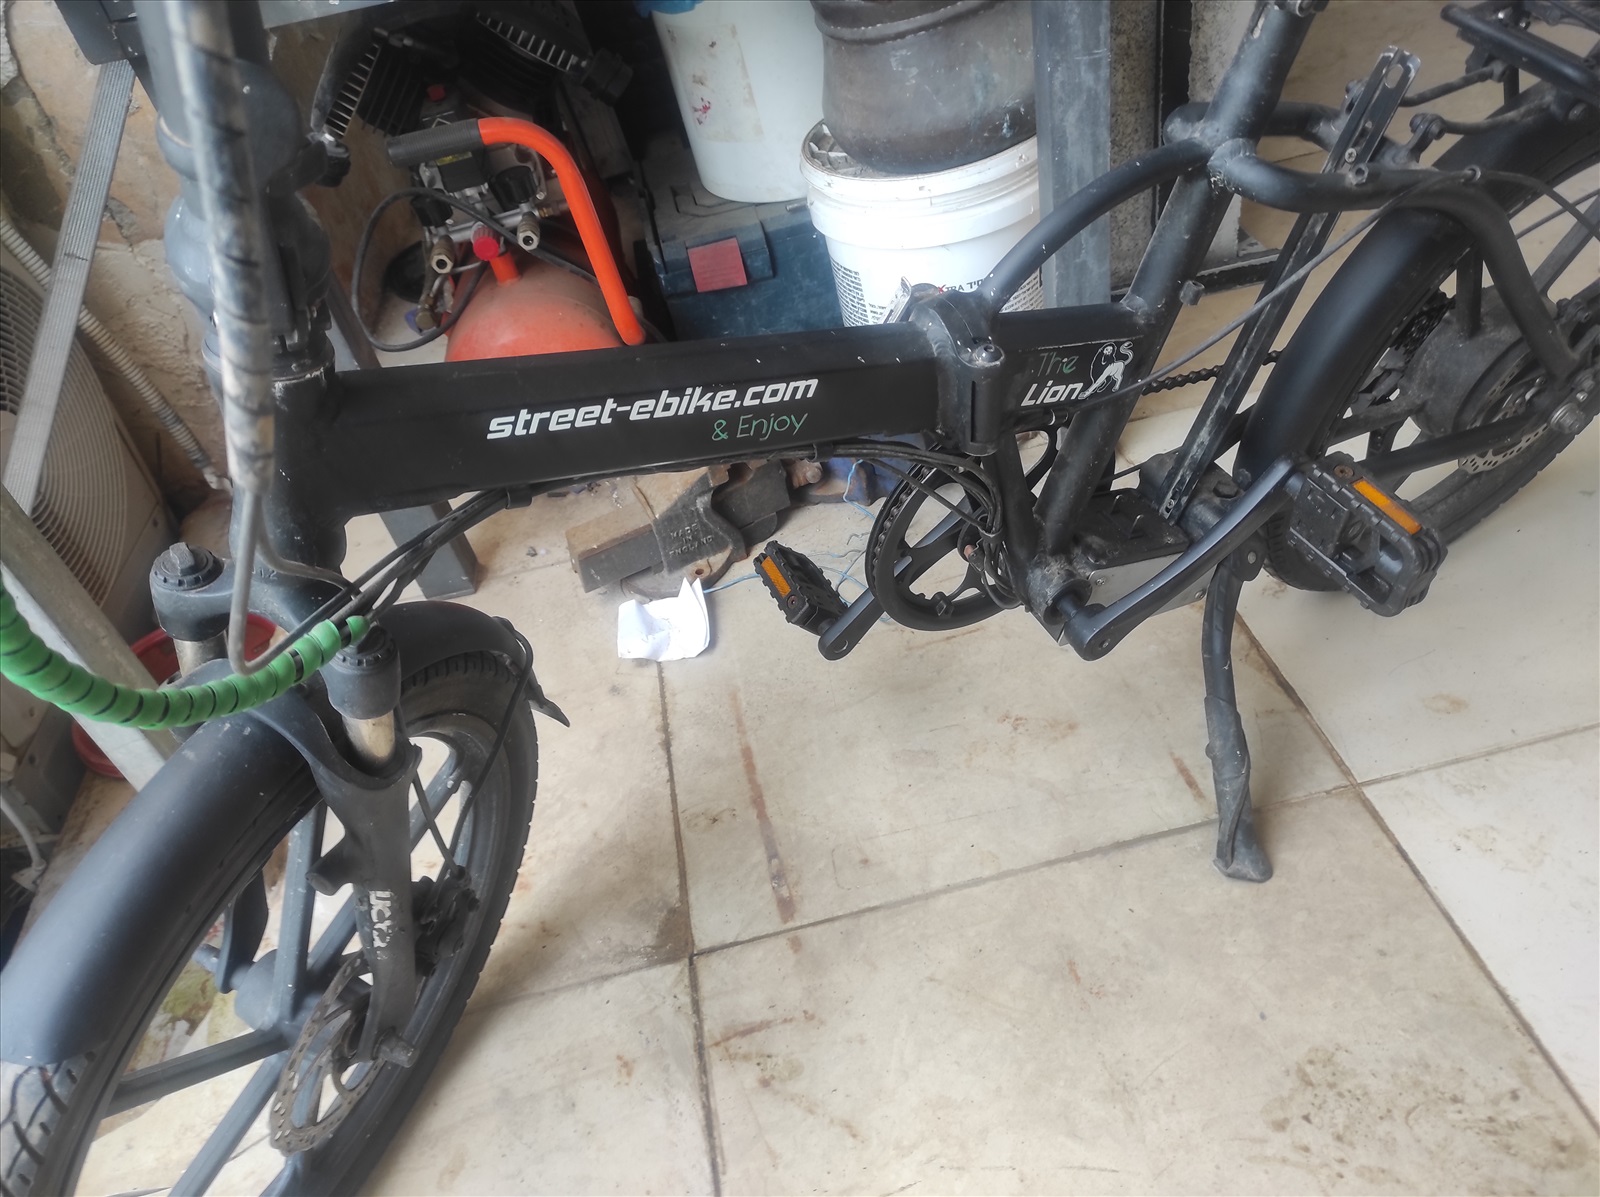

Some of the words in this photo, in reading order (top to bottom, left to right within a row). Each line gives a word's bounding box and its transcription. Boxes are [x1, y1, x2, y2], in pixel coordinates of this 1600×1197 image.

[1038, 351, 1079, 377] The
[1021, 380, 1084, 406] Lion
[486, 378, 819, 440] street-ebike.com
[711, 418, 729, 441] &
[736, 412, 809, 441] Enjoy
[670, 523, 699, 540] MADE
[682, 535, 693, 544] IN
